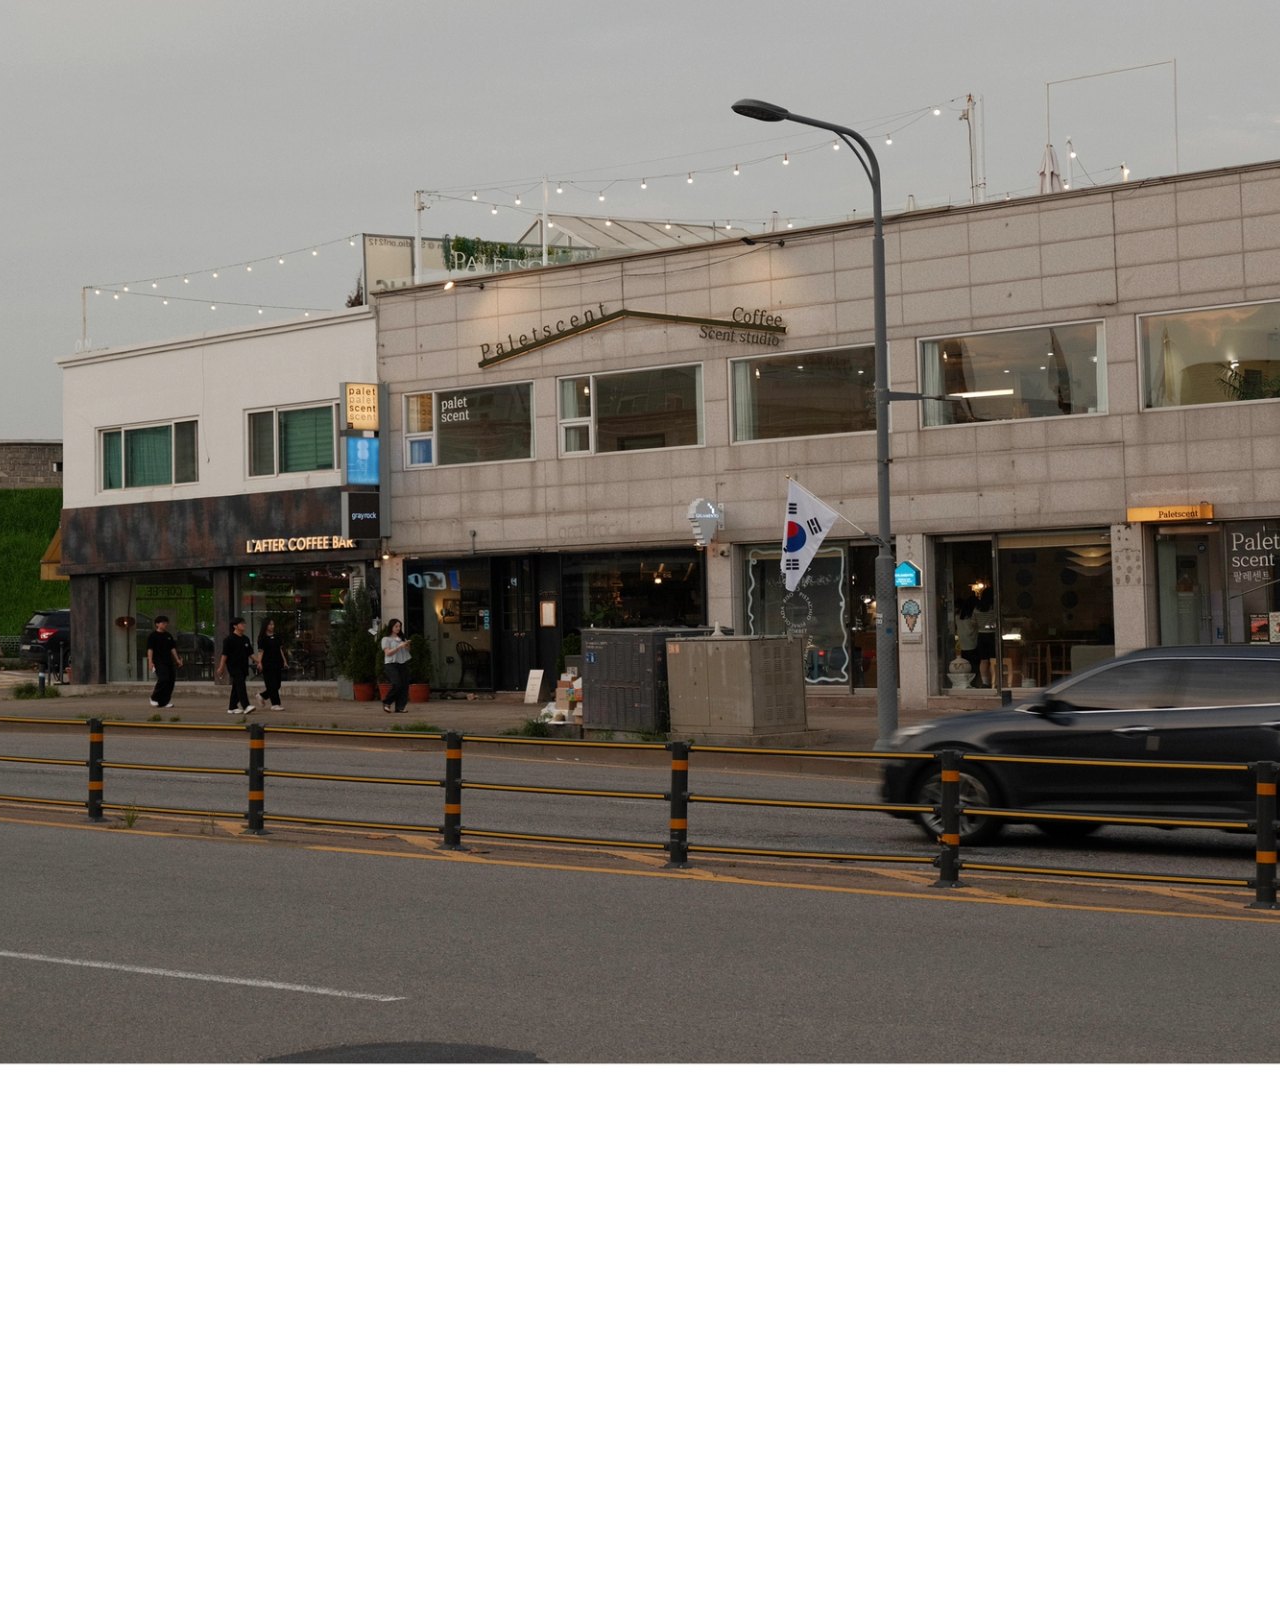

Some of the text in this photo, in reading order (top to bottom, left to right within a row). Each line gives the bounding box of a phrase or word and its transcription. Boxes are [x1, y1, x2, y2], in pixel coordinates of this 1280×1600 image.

[732, 307, 783, 326] Coffee
[480, 302, 606, 360] Paletscent
[699, 325, 781, 346] Scent studio
[349, 387, 376, 397] palet
[349, 404, 376, 413] scent
[441, 396, 467, 413] palet
[441, 409, 470, 422] scent
[351, 511, 377, 520] grayrock
[1158, 509, 1198, 519] Paletscent
[287, 536, 329, 551] COFFEE
[332, 535, 354, 549] BAR
[1231, 532, 1280, 551] Palet
[1231, 554, 1276, 568] scent
[1233, 570, 1271, 583] 팔레센트
